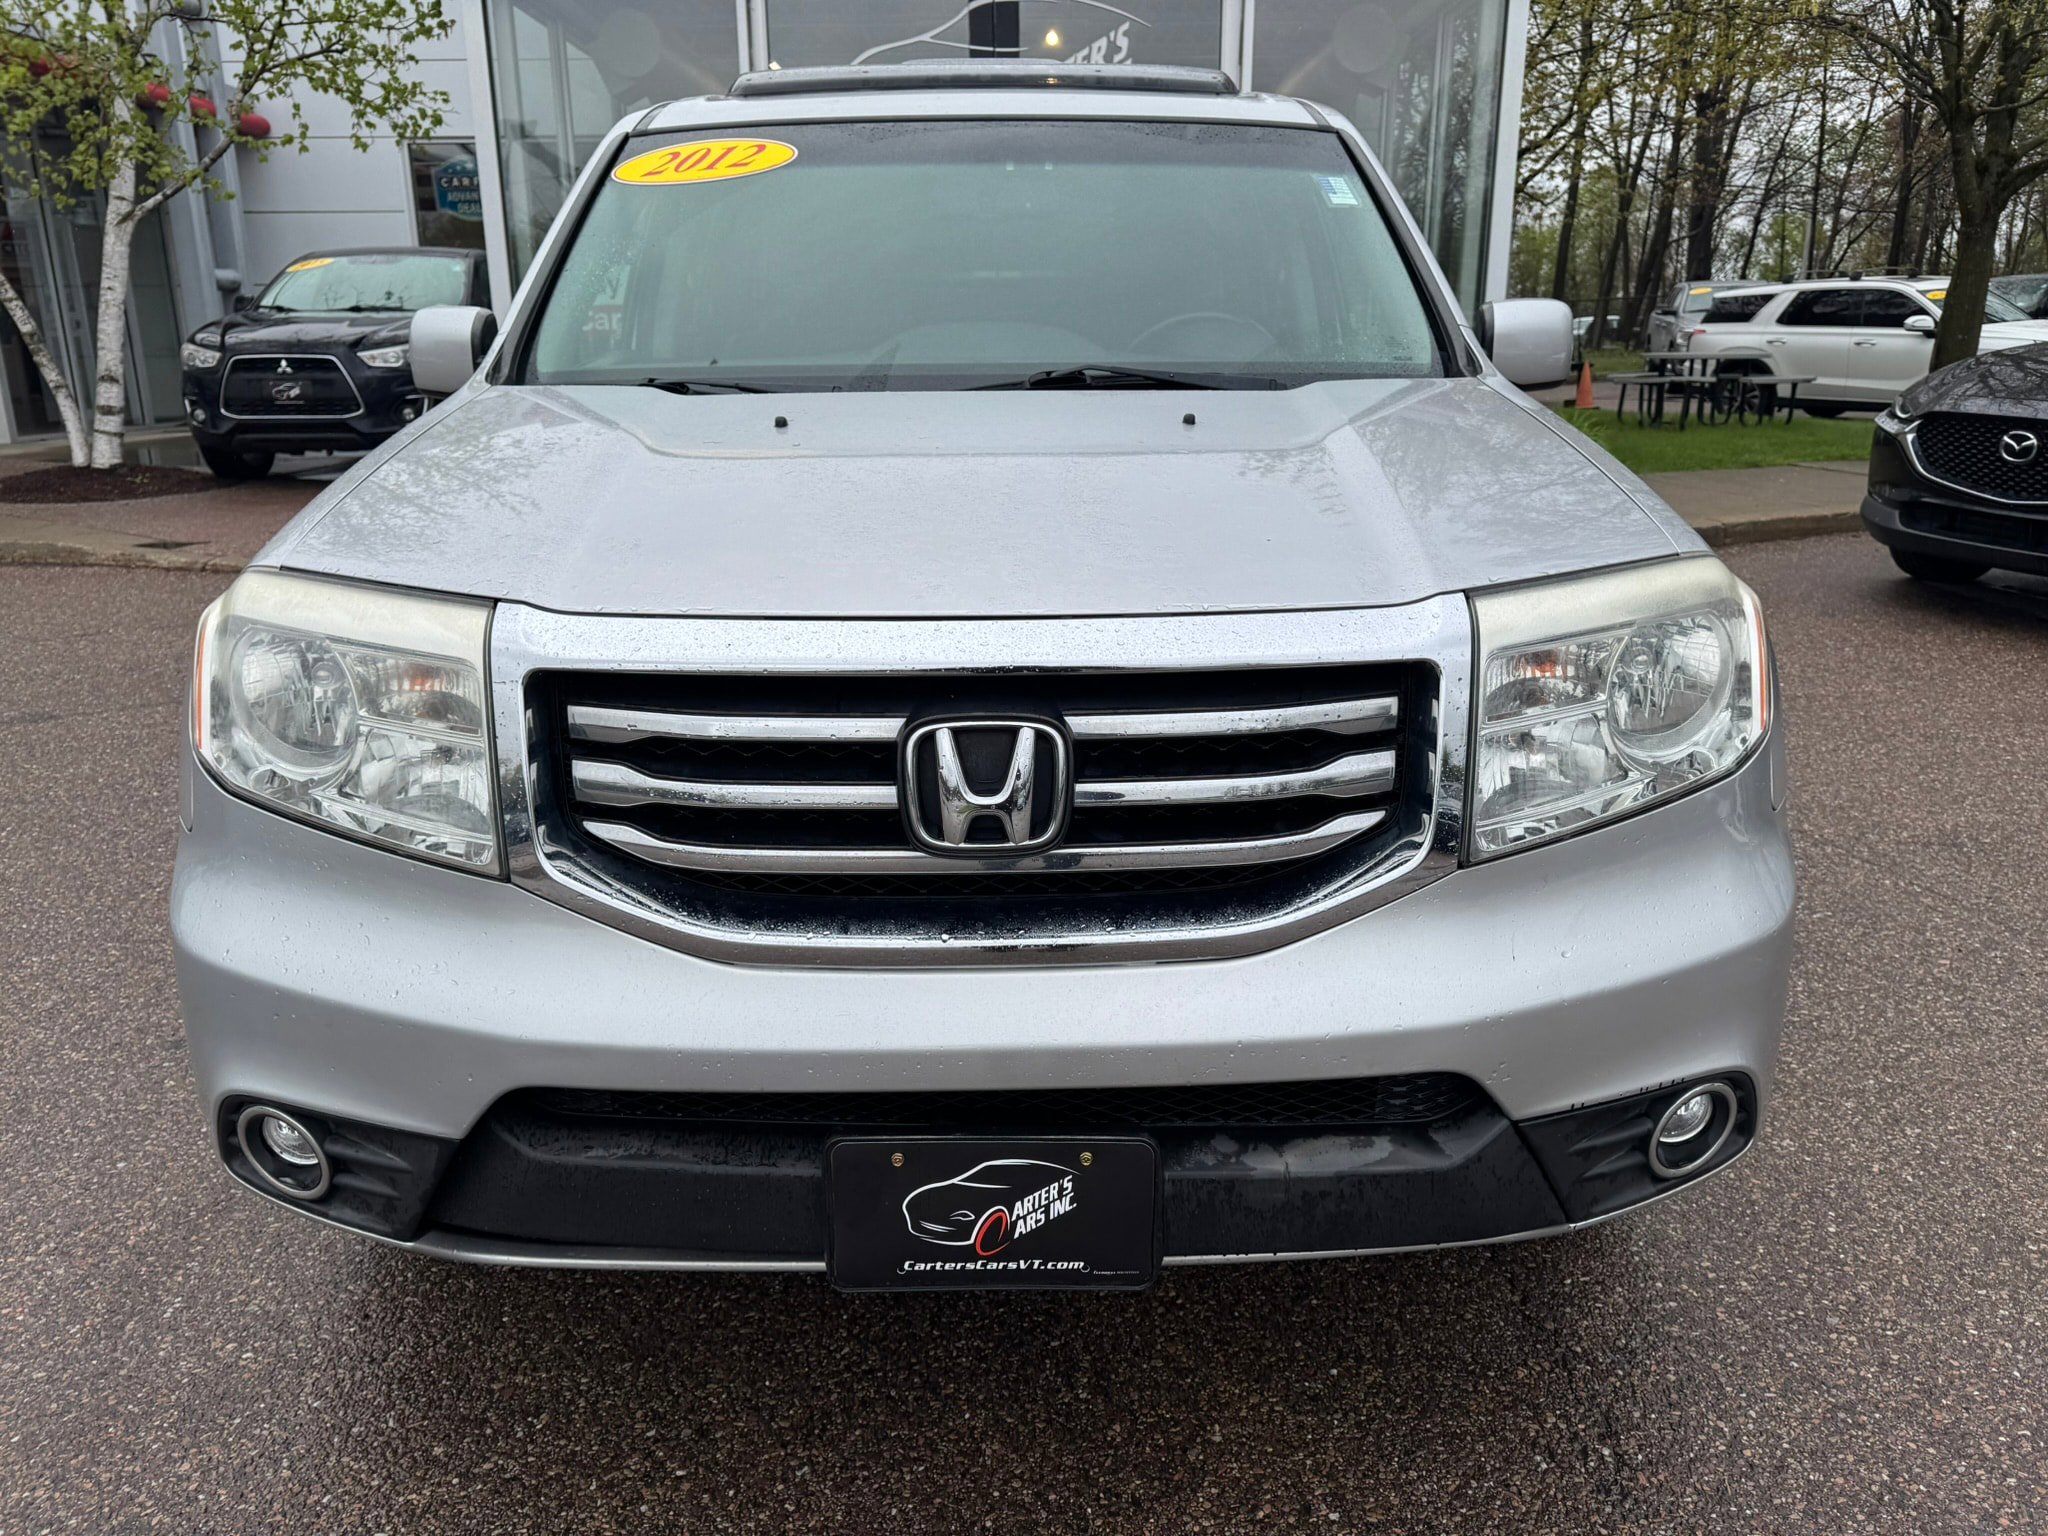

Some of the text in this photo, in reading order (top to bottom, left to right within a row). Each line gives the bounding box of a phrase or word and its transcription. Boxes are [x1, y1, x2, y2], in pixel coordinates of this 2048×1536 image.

[641, 143, 767, 178] 2012
[1049, 1191, 1078, 1220] INC.
[903, 1259, 1085, 1271] CartersCarsVT.com
